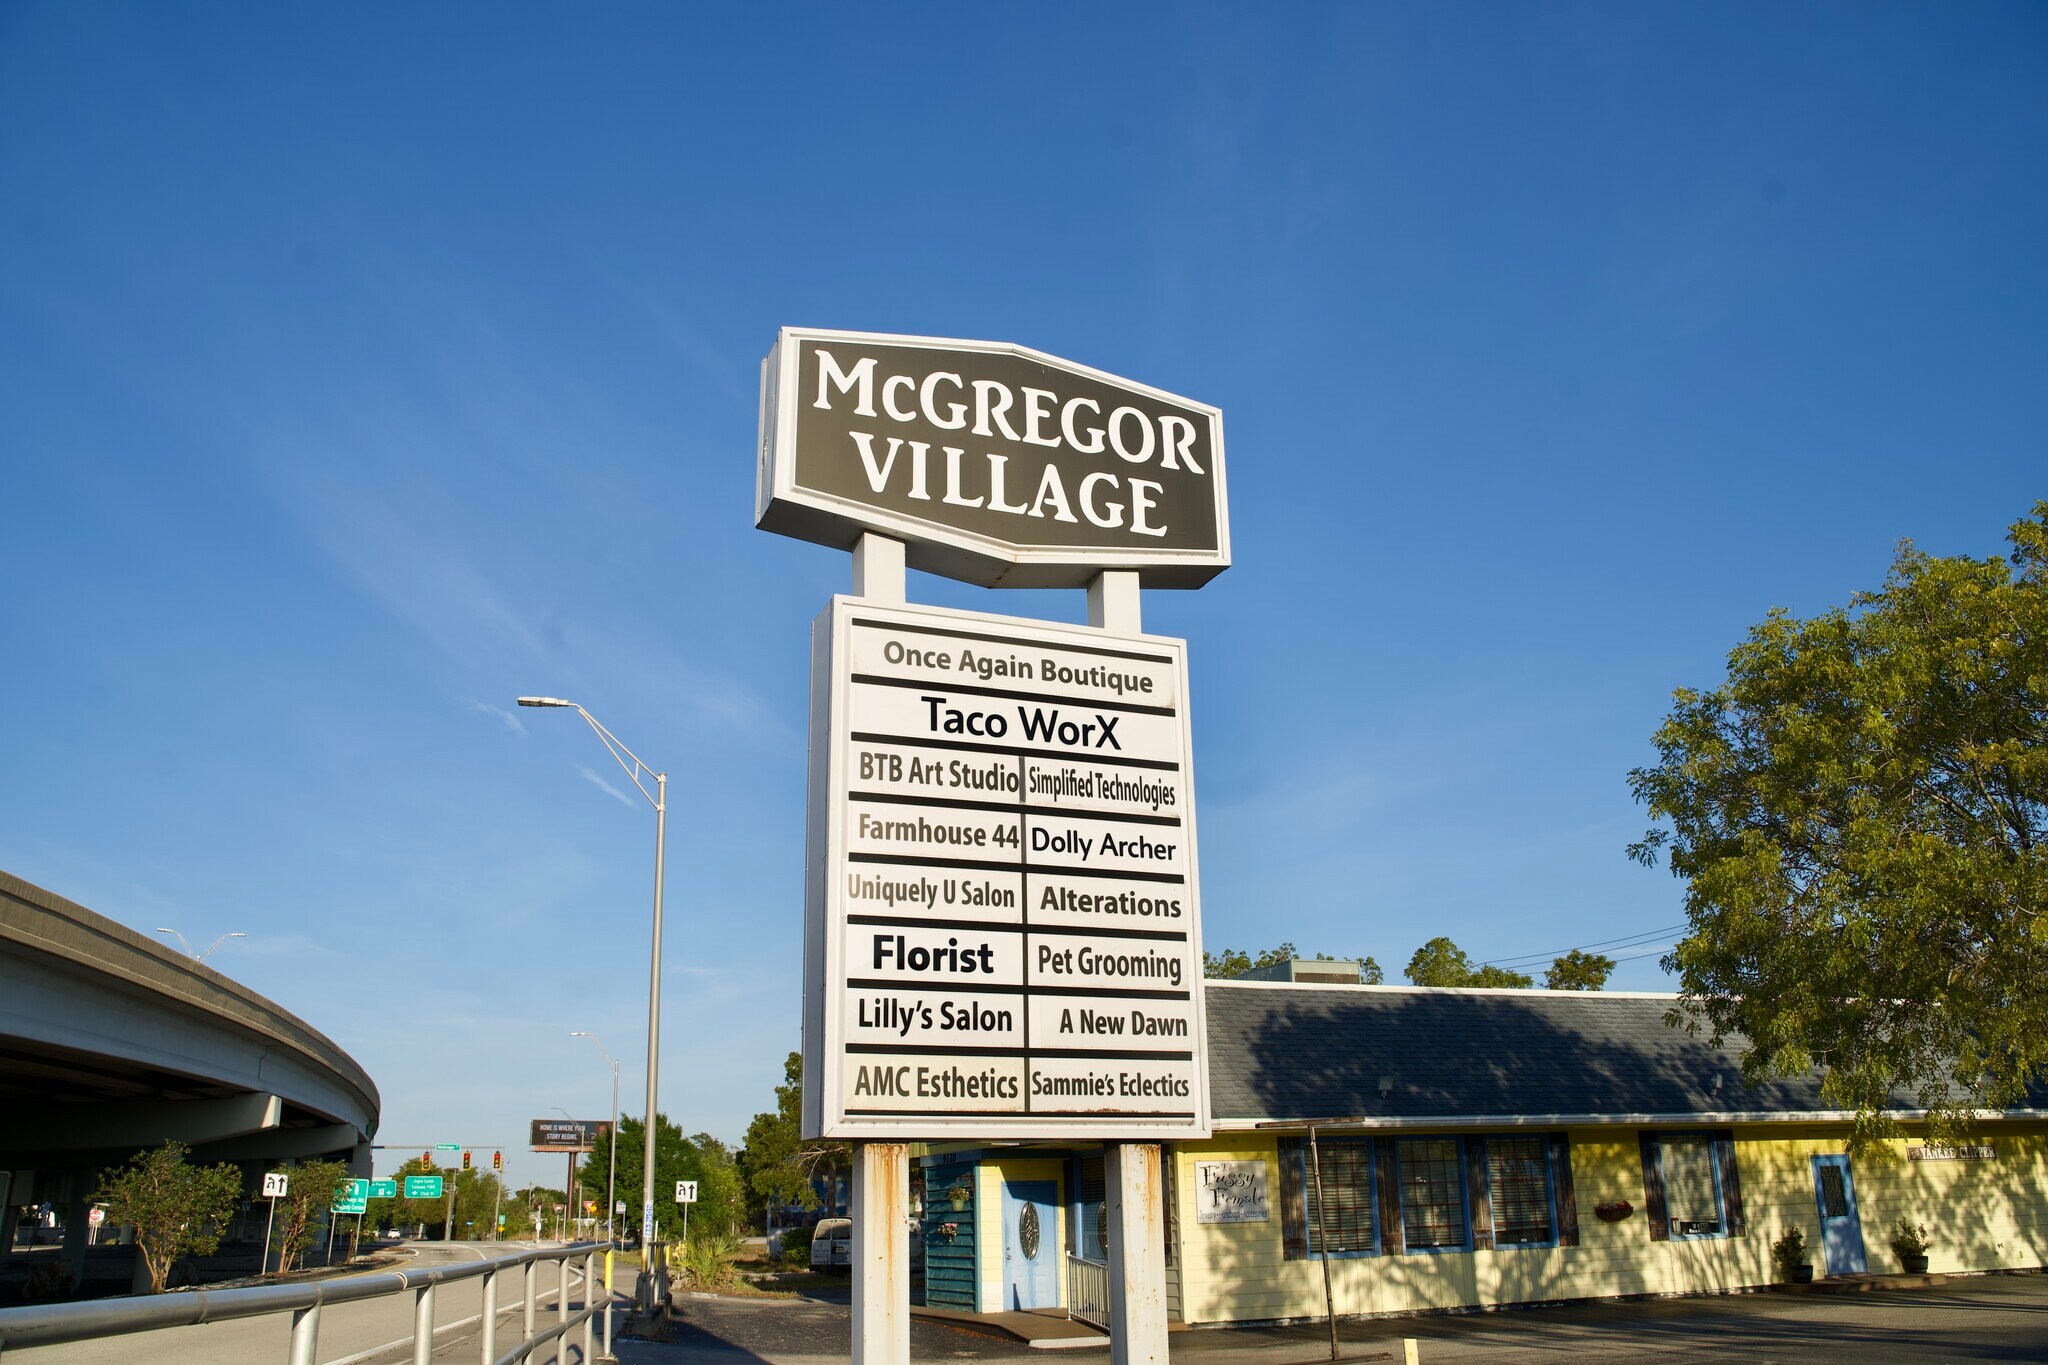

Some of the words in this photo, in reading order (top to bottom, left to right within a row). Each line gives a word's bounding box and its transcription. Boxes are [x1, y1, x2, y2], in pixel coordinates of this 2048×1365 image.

[813, 349, 1204, 475] McGREGOR
[849, 431, 1168, 537] VILLAGE
[884, 641, 951, 670] Once
[959, 650, 1033, 681] Again
[1041, 659, 1153, 695] Boutique
[921, 696, 1007, 738] Taco
[1018, 706, 1122, 751] WorX
[860, 752, 903, 782] BTB
[908, 757, 943, 787] Art
[949, 760, 1019, 793] Studio
[1029, 766, 1093, 804] Simplified
[1095, 772, 1175, 811] Technologies
[859, 814, 987, 847] Farmhouse
[992, 825, 1019, 849] 44
[1032, 827, 1093, 862] Dolly
[1100, 833, 1176, 861] Archer
[848, 874, 937, 910] Uniquely
[943, 882, 956, 904] U
[961, 881, 1015, 908] Salon
[1040, 886, 1182, 918] Alterations
[874, 934, 994, 974] Florist
[1038, 945, 1073, 975] Pet
[1078, 946, 1182, 987] Grooming
[858, 998, 932, 1038] Lilly's
[940, 1001, 1012, 1032] Salon
[1060, 1009, 1074, 1034] A
[1080, 1009, 1124, 1035] New
[1132, 1011, 1188, 1037] Dawn
[855, 1066, 910, 1097] AMC
[917, 1066, 1018, 1099] Esthetics
[1032, 1071, 1114, 1097] Sammie's
[1120, 1072, 1189, 1098] Eclectics
[1960, 1146, 1995, 1159] CLIPPER
[1200, 1165, 1255, 1189] Fussy
[1209, 1187, 1265, 1208] Female
